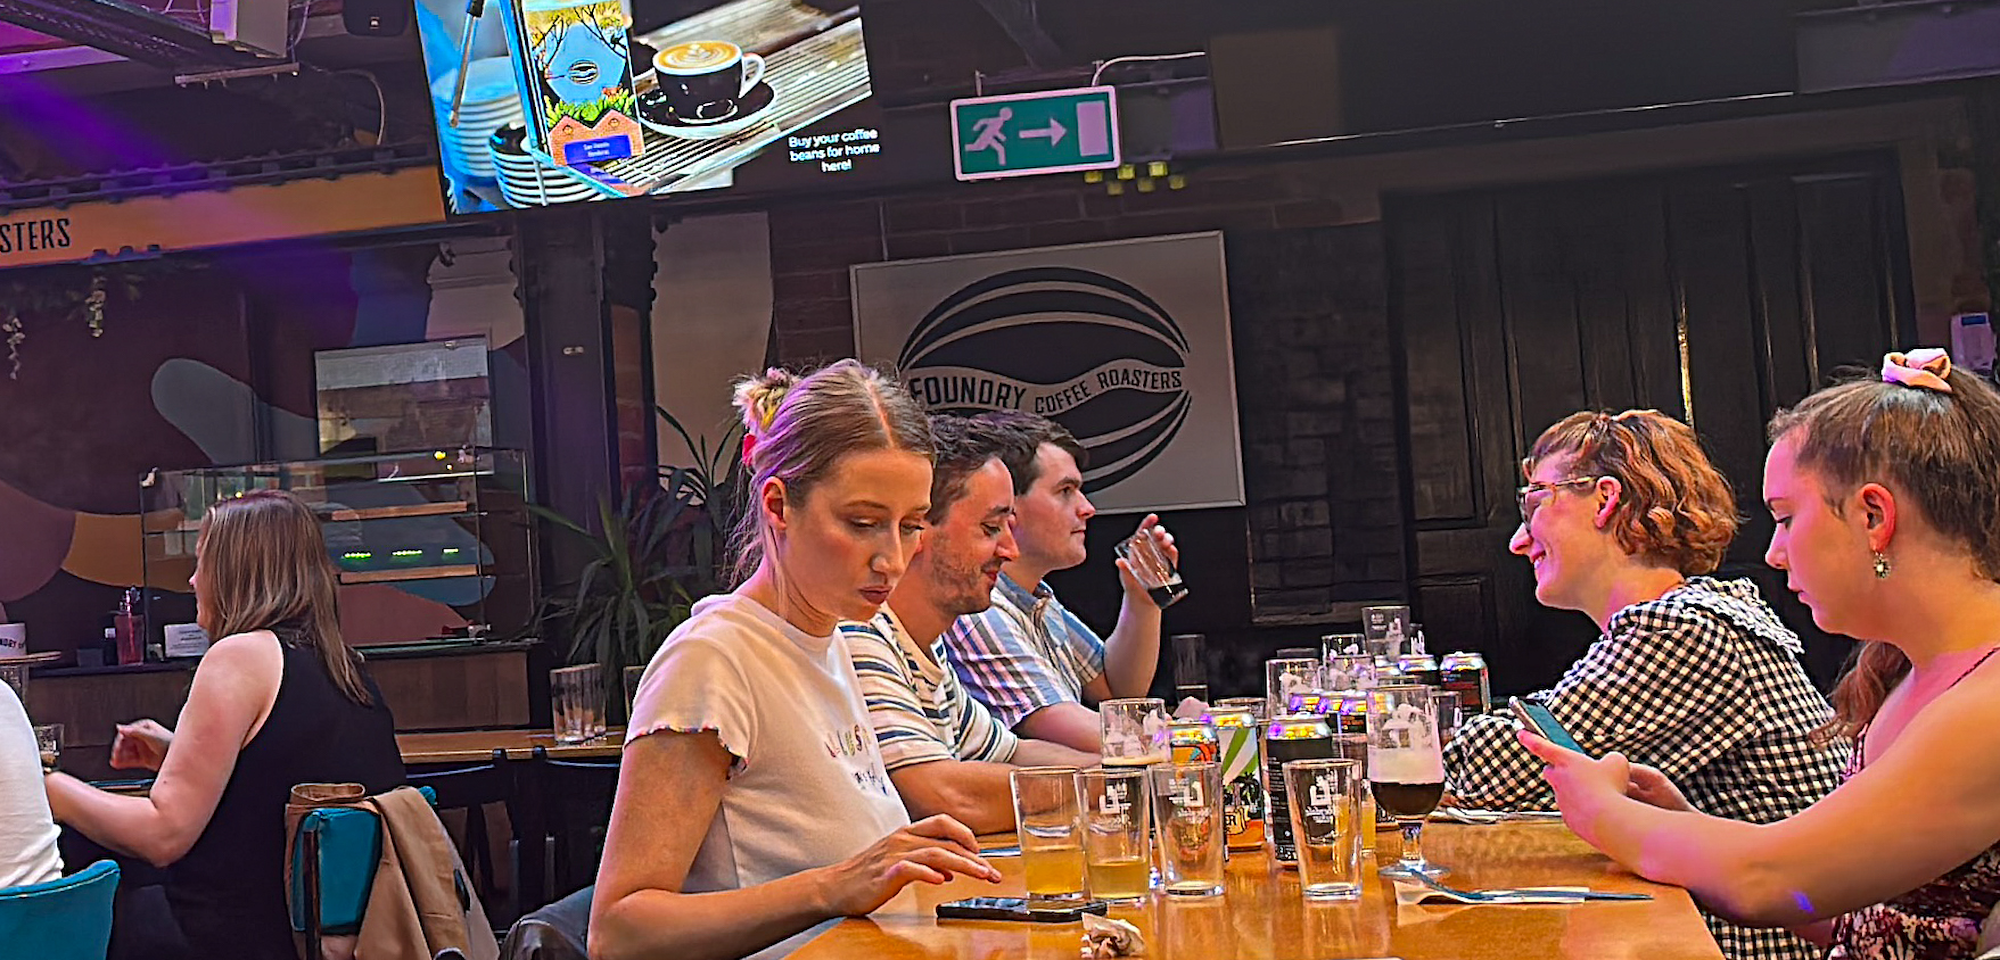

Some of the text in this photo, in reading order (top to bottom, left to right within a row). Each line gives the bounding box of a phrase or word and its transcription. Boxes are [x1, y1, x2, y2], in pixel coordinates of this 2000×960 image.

[788, 128, 878, 148] Buy your coffee
[790, 144, 880, 161] beans for home
[821, 159, 852, 172] here!
[0, 218, 70, 253] STERS
[909, 368, 1181, 413] FOUNDRY COFFEE ROASTERS
